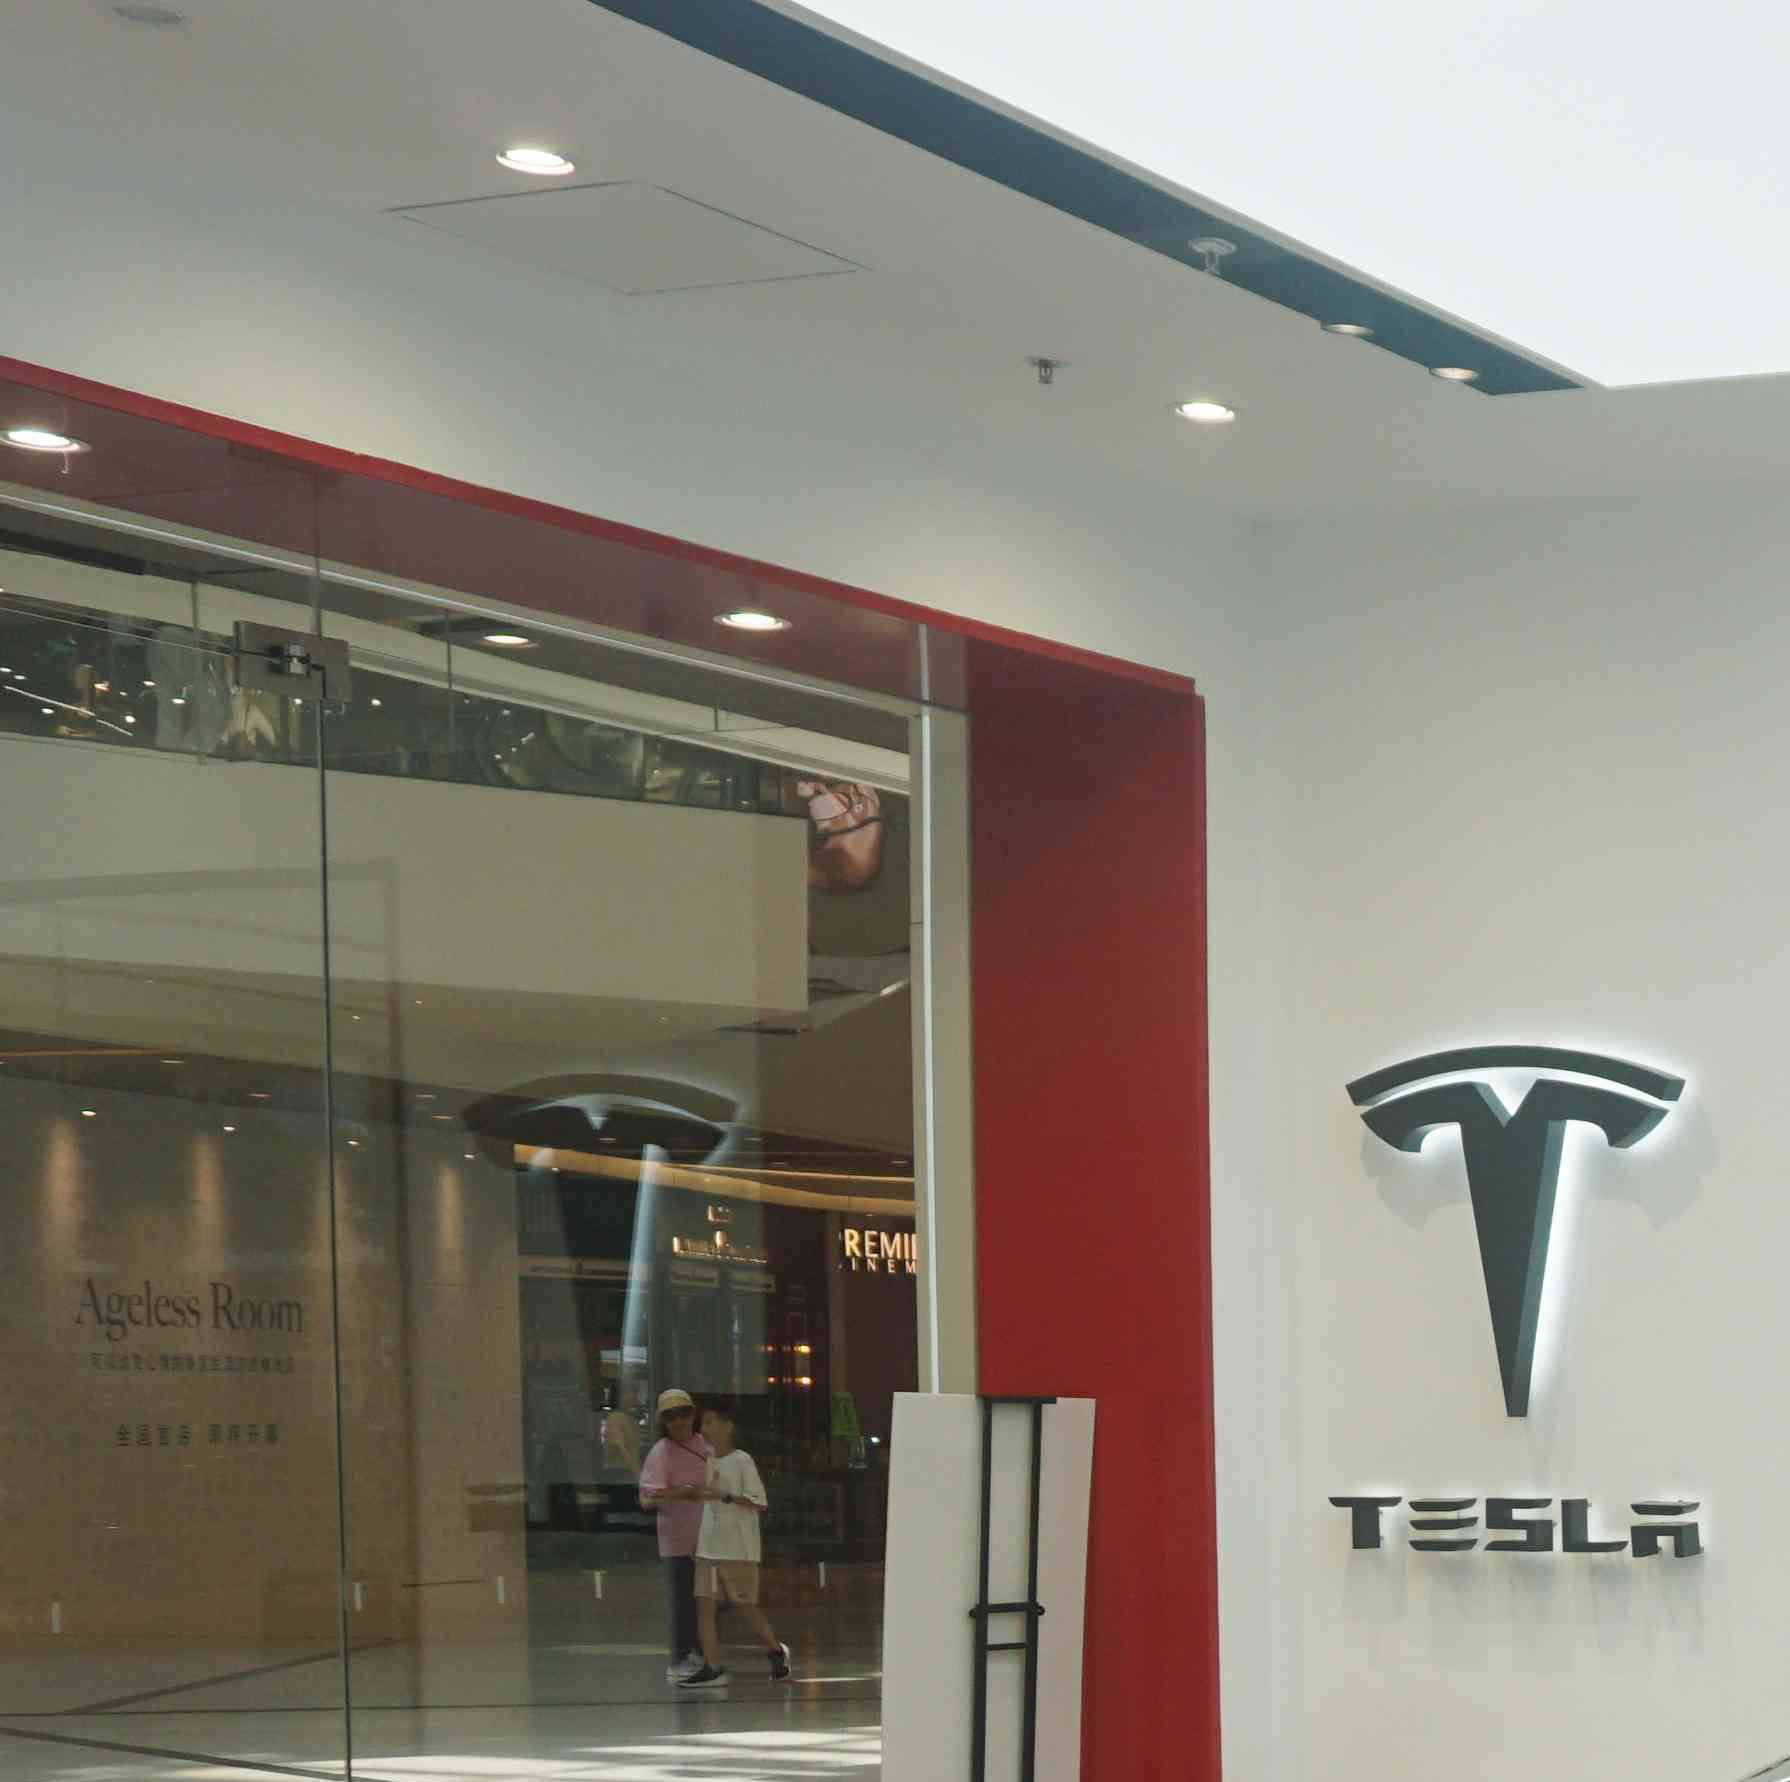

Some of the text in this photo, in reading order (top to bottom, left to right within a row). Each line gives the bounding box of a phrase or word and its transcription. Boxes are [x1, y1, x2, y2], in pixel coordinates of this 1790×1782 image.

[74, 1277, 303, 1341] Ageless Room
[1328, 1496, 1702, 1558] TESLA
